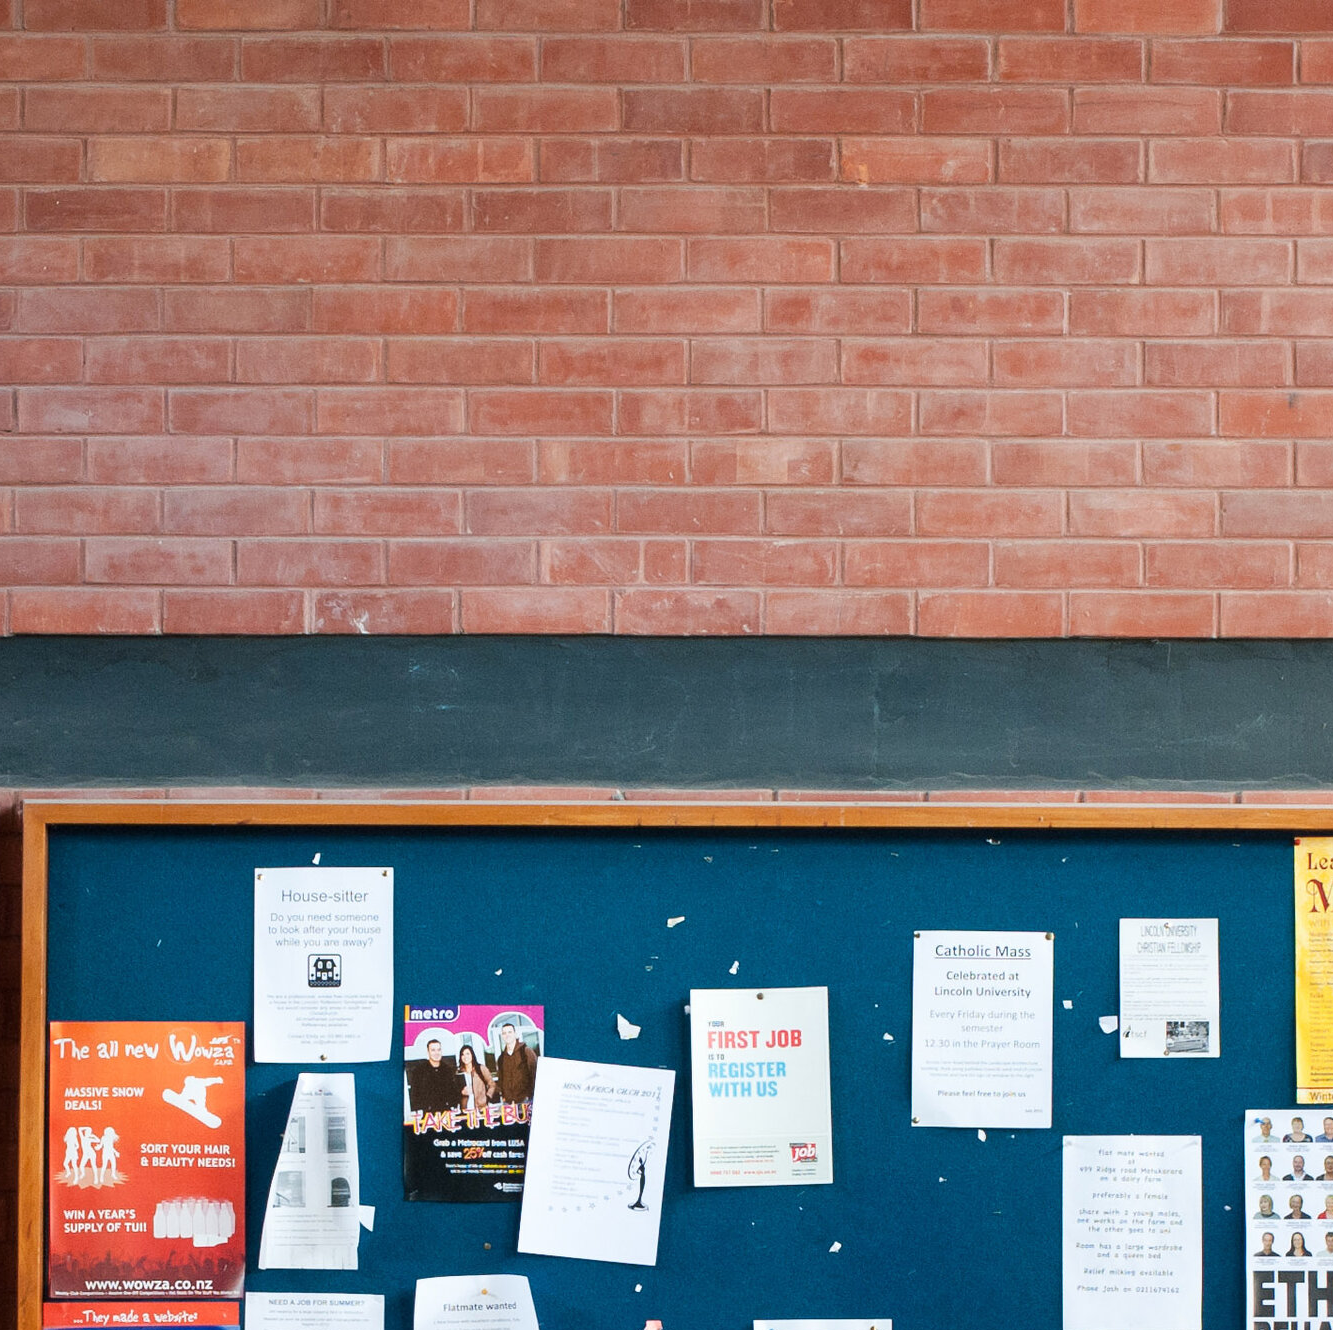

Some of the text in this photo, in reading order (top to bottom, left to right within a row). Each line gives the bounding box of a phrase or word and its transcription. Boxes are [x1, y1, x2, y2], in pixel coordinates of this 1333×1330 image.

[281, 890, 369, 903] House-sitter
[270, 912, 379, 924] Do you need someone
[935, 944, 1031, 958] Catholic Mass
[946, 970, 1020, 981] Celebrated at
[934, 986, 1031, 998] Lincoln University
[410, 1008, 455, 1020] metro
[707, 1029, 802, 1049] FIRST JOB
[53, 1037, 90, 1061] The
[97, 1040, 118, 1058] all
[124, 1041, 159, 1060] new
[708, 1061, 786, 1079] REGISTER
[64, 1087, 144, 1098] MASSIVE SNOW
[708, 1081, 778, 1098] WITH US
[64, 1100, 102, 1111] DEALS!
[411, 1103, 500, 1134] TAKE THE
[140, 1143, 230, 1155] SORT YOUR HAIR
[140, 1156, 236, 1168] & BEAUTY NEEDS!
[63, 1209, 136, 1220] WIN A YEAR'S
[64, 1221, 147, 1234] SUPPLY OF TUI!
[85, 1279, 213, 1291] www.wowza.co.nz
[443, 1301, 517, 1312] Flatmate wanted
